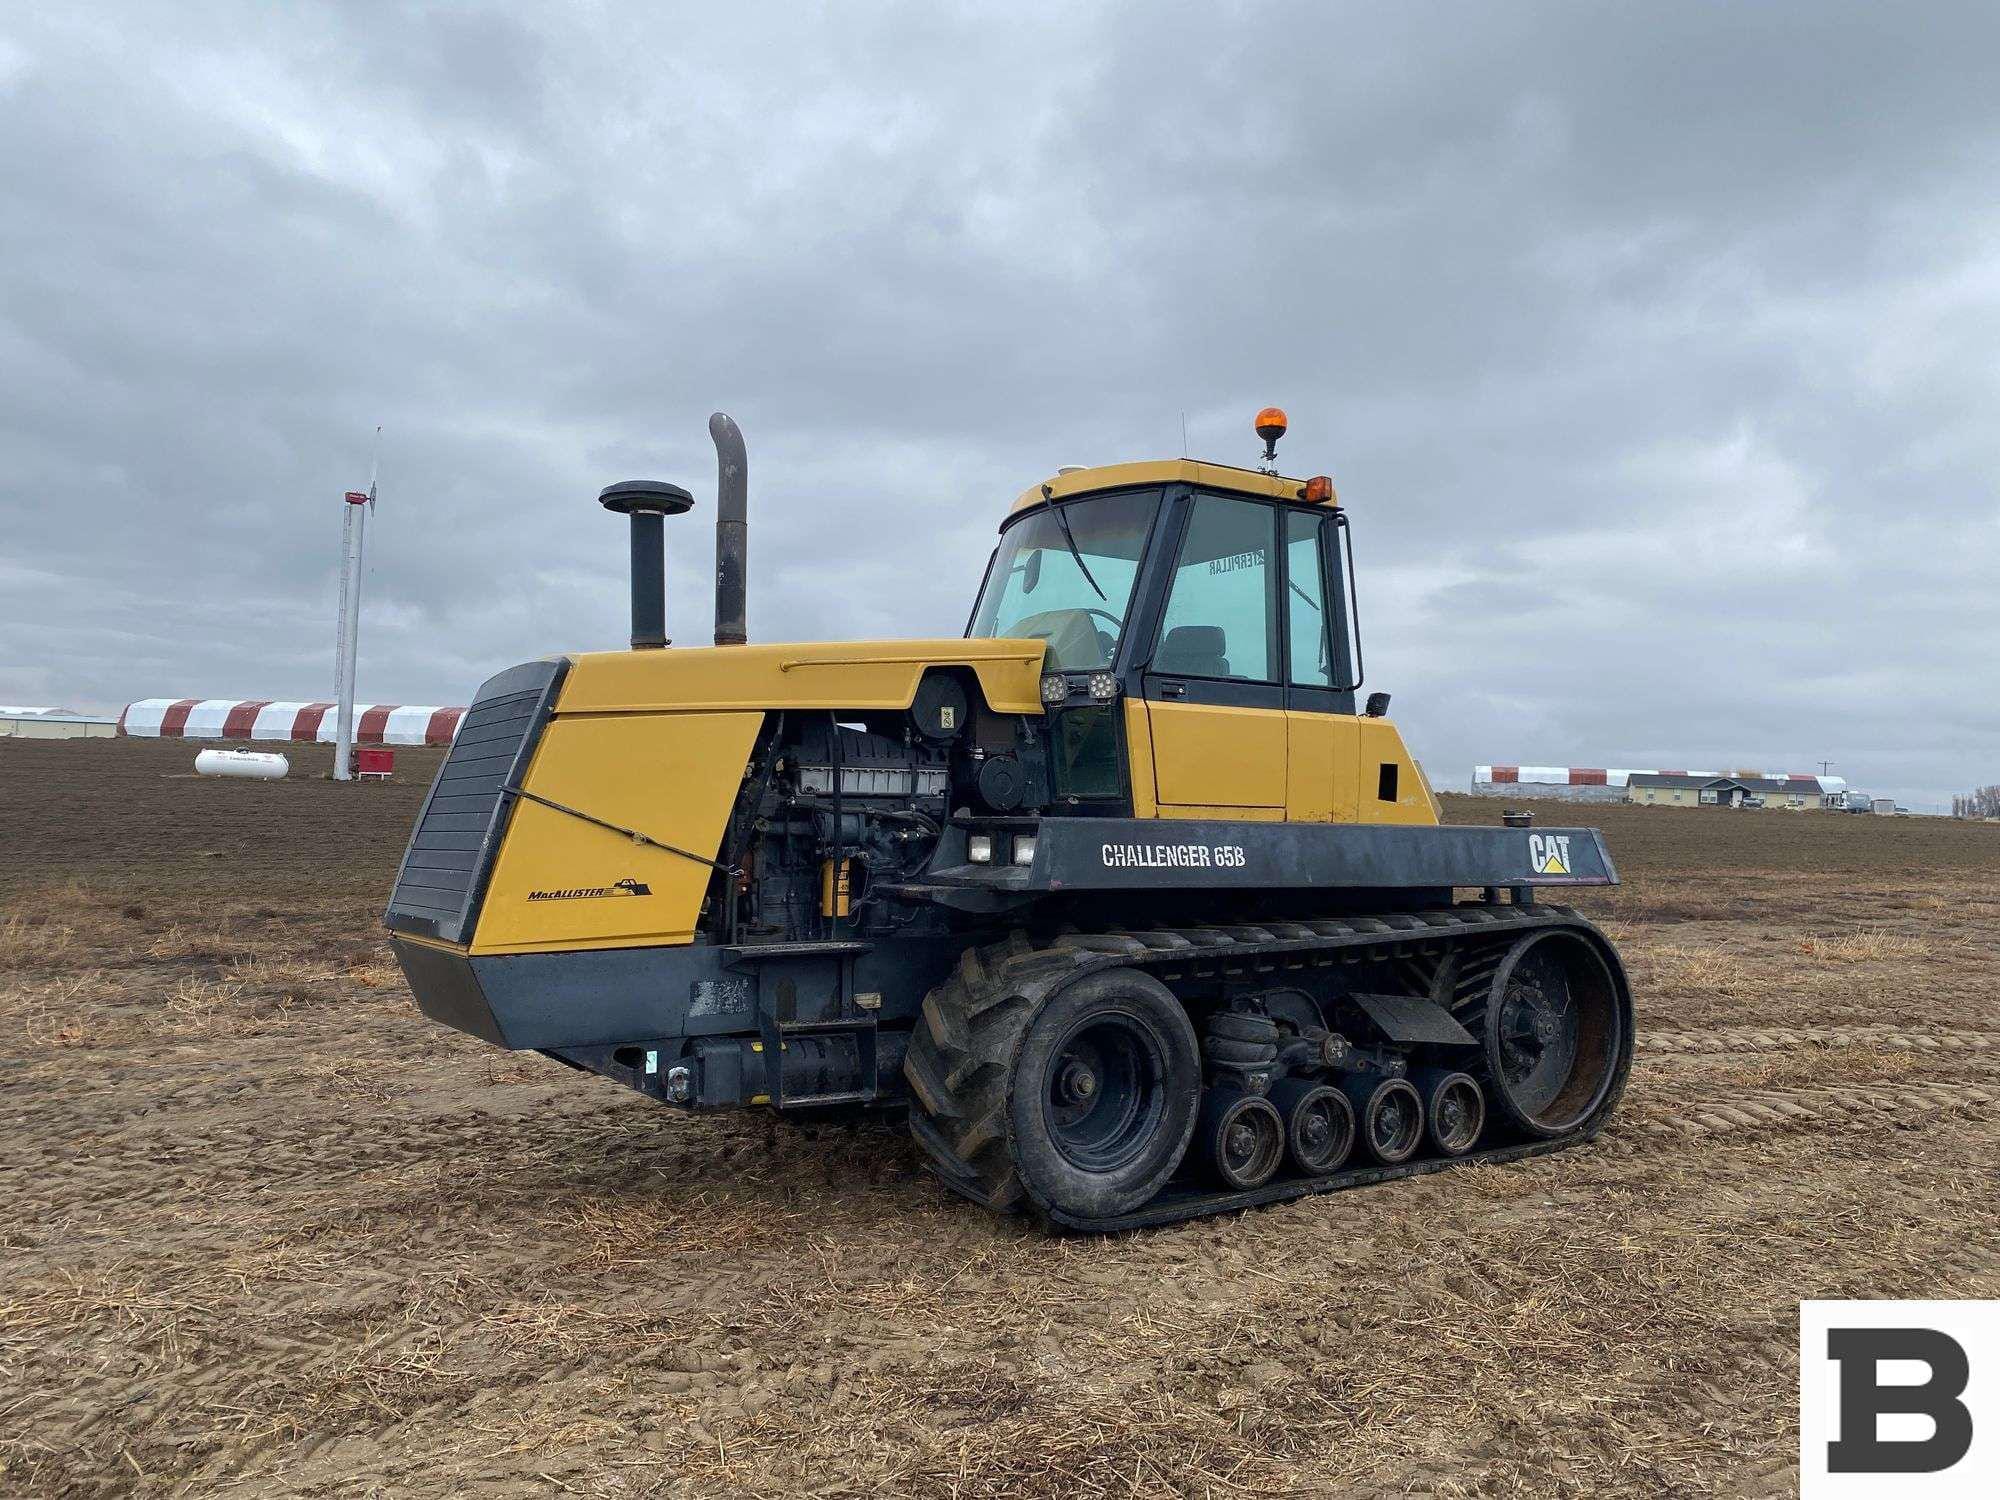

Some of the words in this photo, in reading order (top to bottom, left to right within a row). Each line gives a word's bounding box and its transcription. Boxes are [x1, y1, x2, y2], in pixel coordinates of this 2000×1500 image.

[1102, 844, 1211, 867] CHALLENGER
[1214, 845, 1246, 867] 65B
[1528, 834, 1571, 873] CAT
